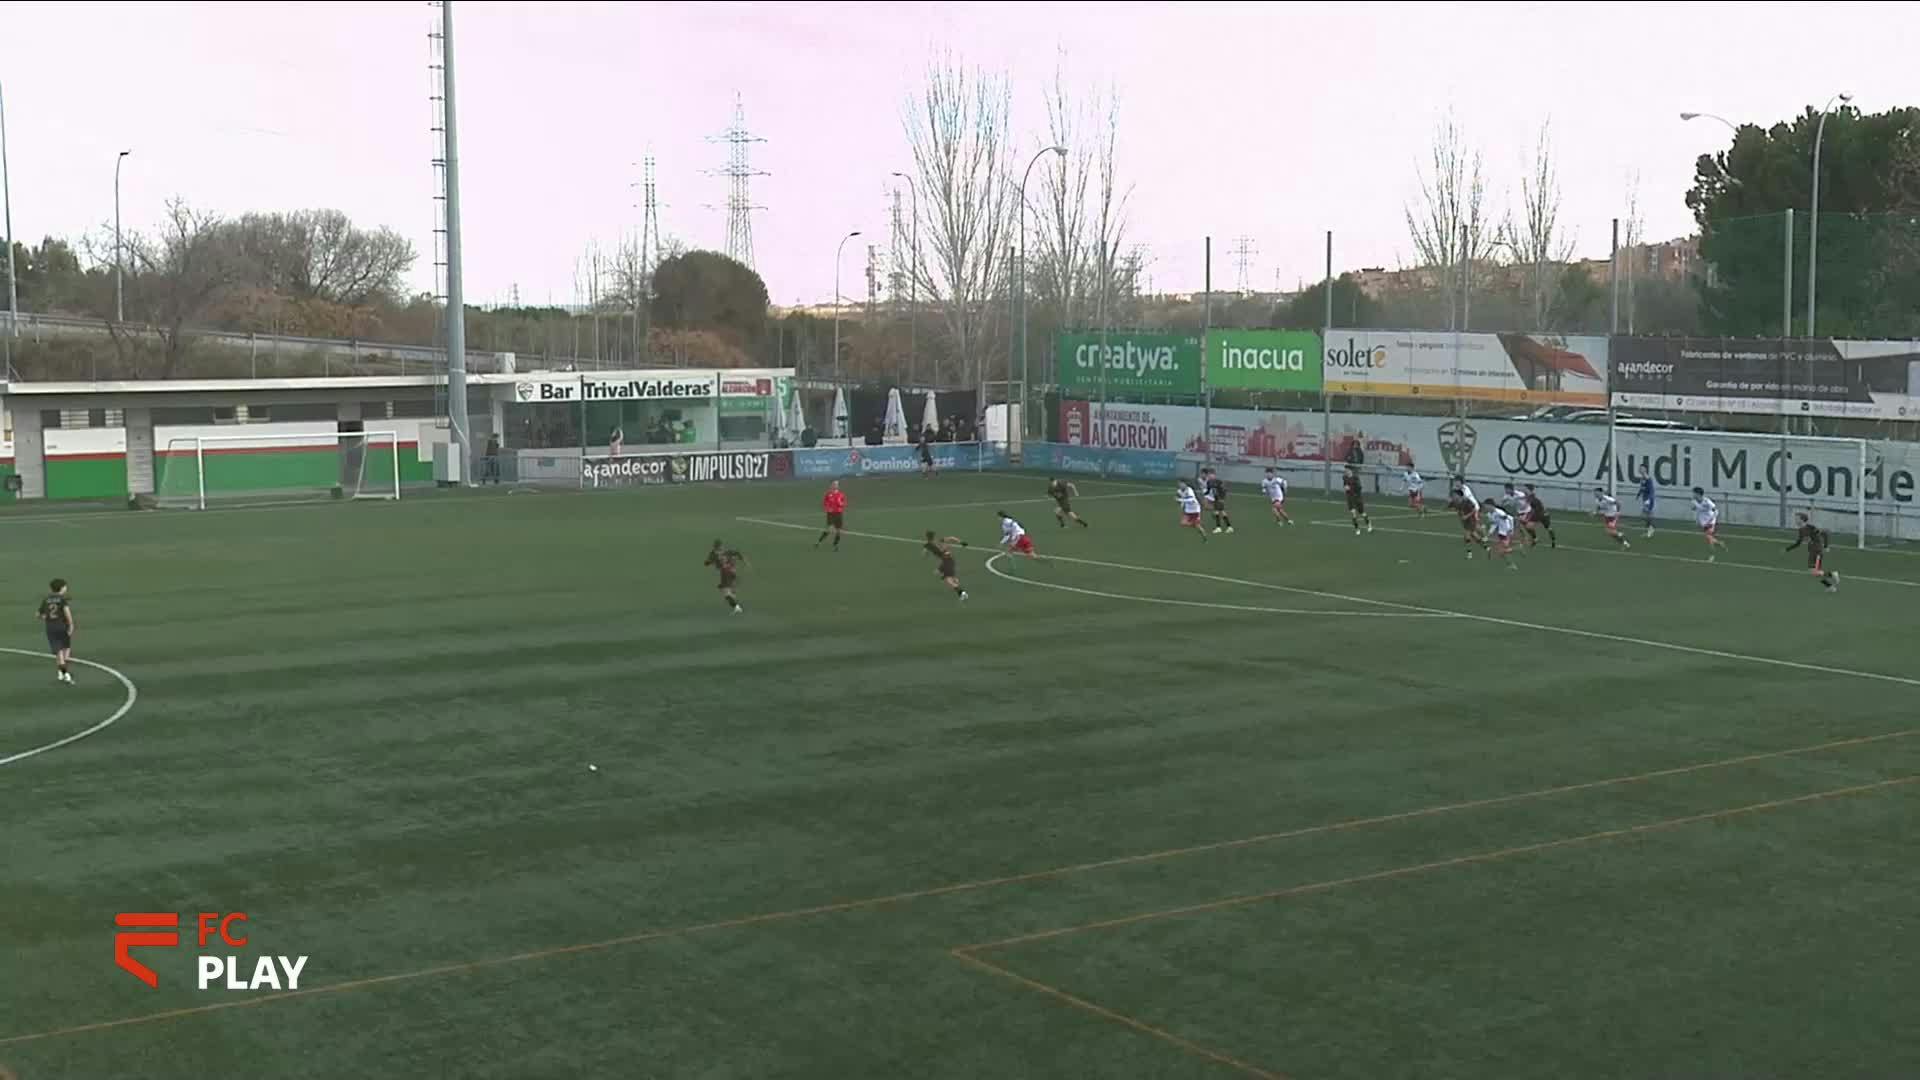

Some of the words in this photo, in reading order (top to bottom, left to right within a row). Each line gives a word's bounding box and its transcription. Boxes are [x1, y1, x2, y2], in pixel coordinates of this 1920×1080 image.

[1076, 341, 1179, 377] creatyva.
[1222, 341, 1303, 370] inacua
[540, 383, 573, 400] Bar
[584, 380, 711, 398] TrivalValderas
[584, 459, 667, 487] afandecor
[690, 454, 769, 481] IMPULSO27
[861, 456, 919, 471] Domino's
[1596, 444, 1692, 487] Audi
[49, 604, 58, 618] 2
